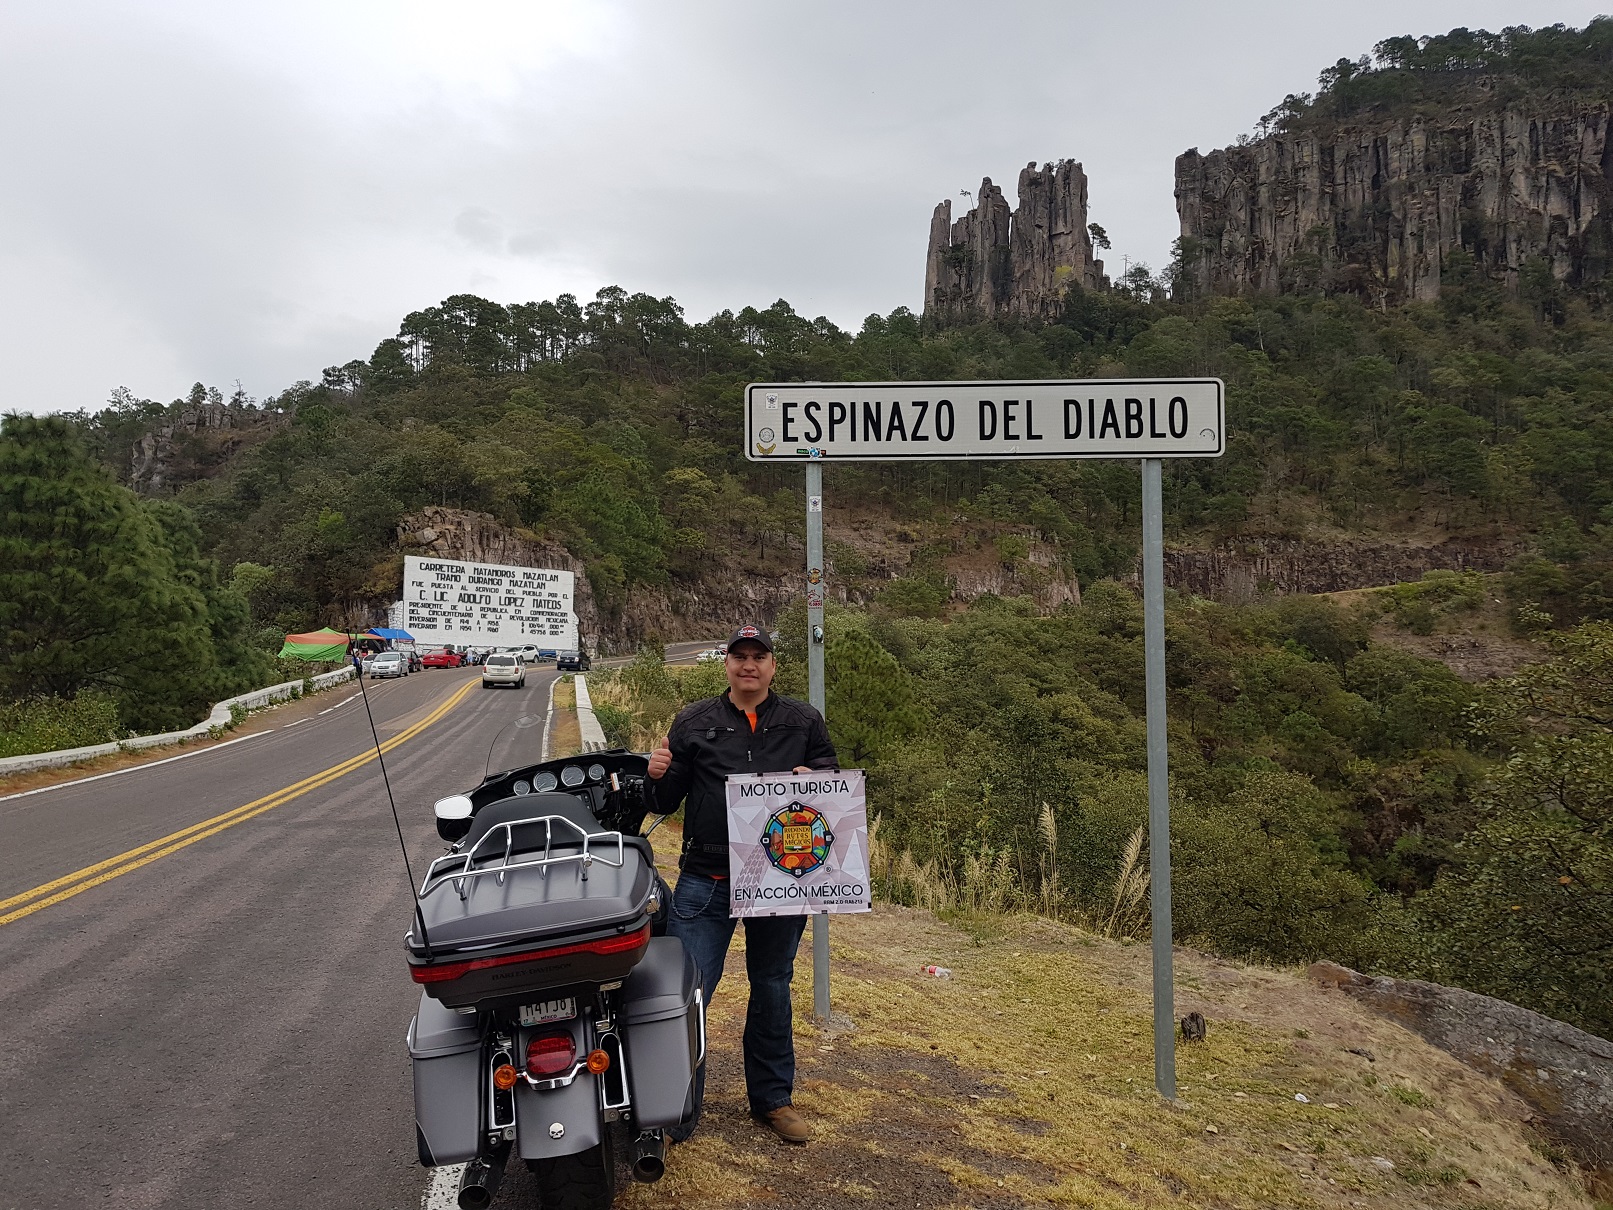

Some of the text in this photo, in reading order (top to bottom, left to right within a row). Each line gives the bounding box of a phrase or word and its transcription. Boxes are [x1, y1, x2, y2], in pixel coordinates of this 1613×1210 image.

[782, 396, 1188, 443] ESPINAZO DEL DIABLO
[420, 562, 559, 582] CARRETERA MATAMOROS MAZATLAN
[436, 573, 546, 589] TRAMO DURANGO MAZATLAN
[420, 590, 562, 610] C. LIC. ADOLFO LOPEZ MATEOS
[428, 610, 473, 618] CINCUENTENARIO
[741, 780, 849, 797] MOTO TURISTA
[735, 882, 863, 900] EN ACCIÓN MÉXICO
